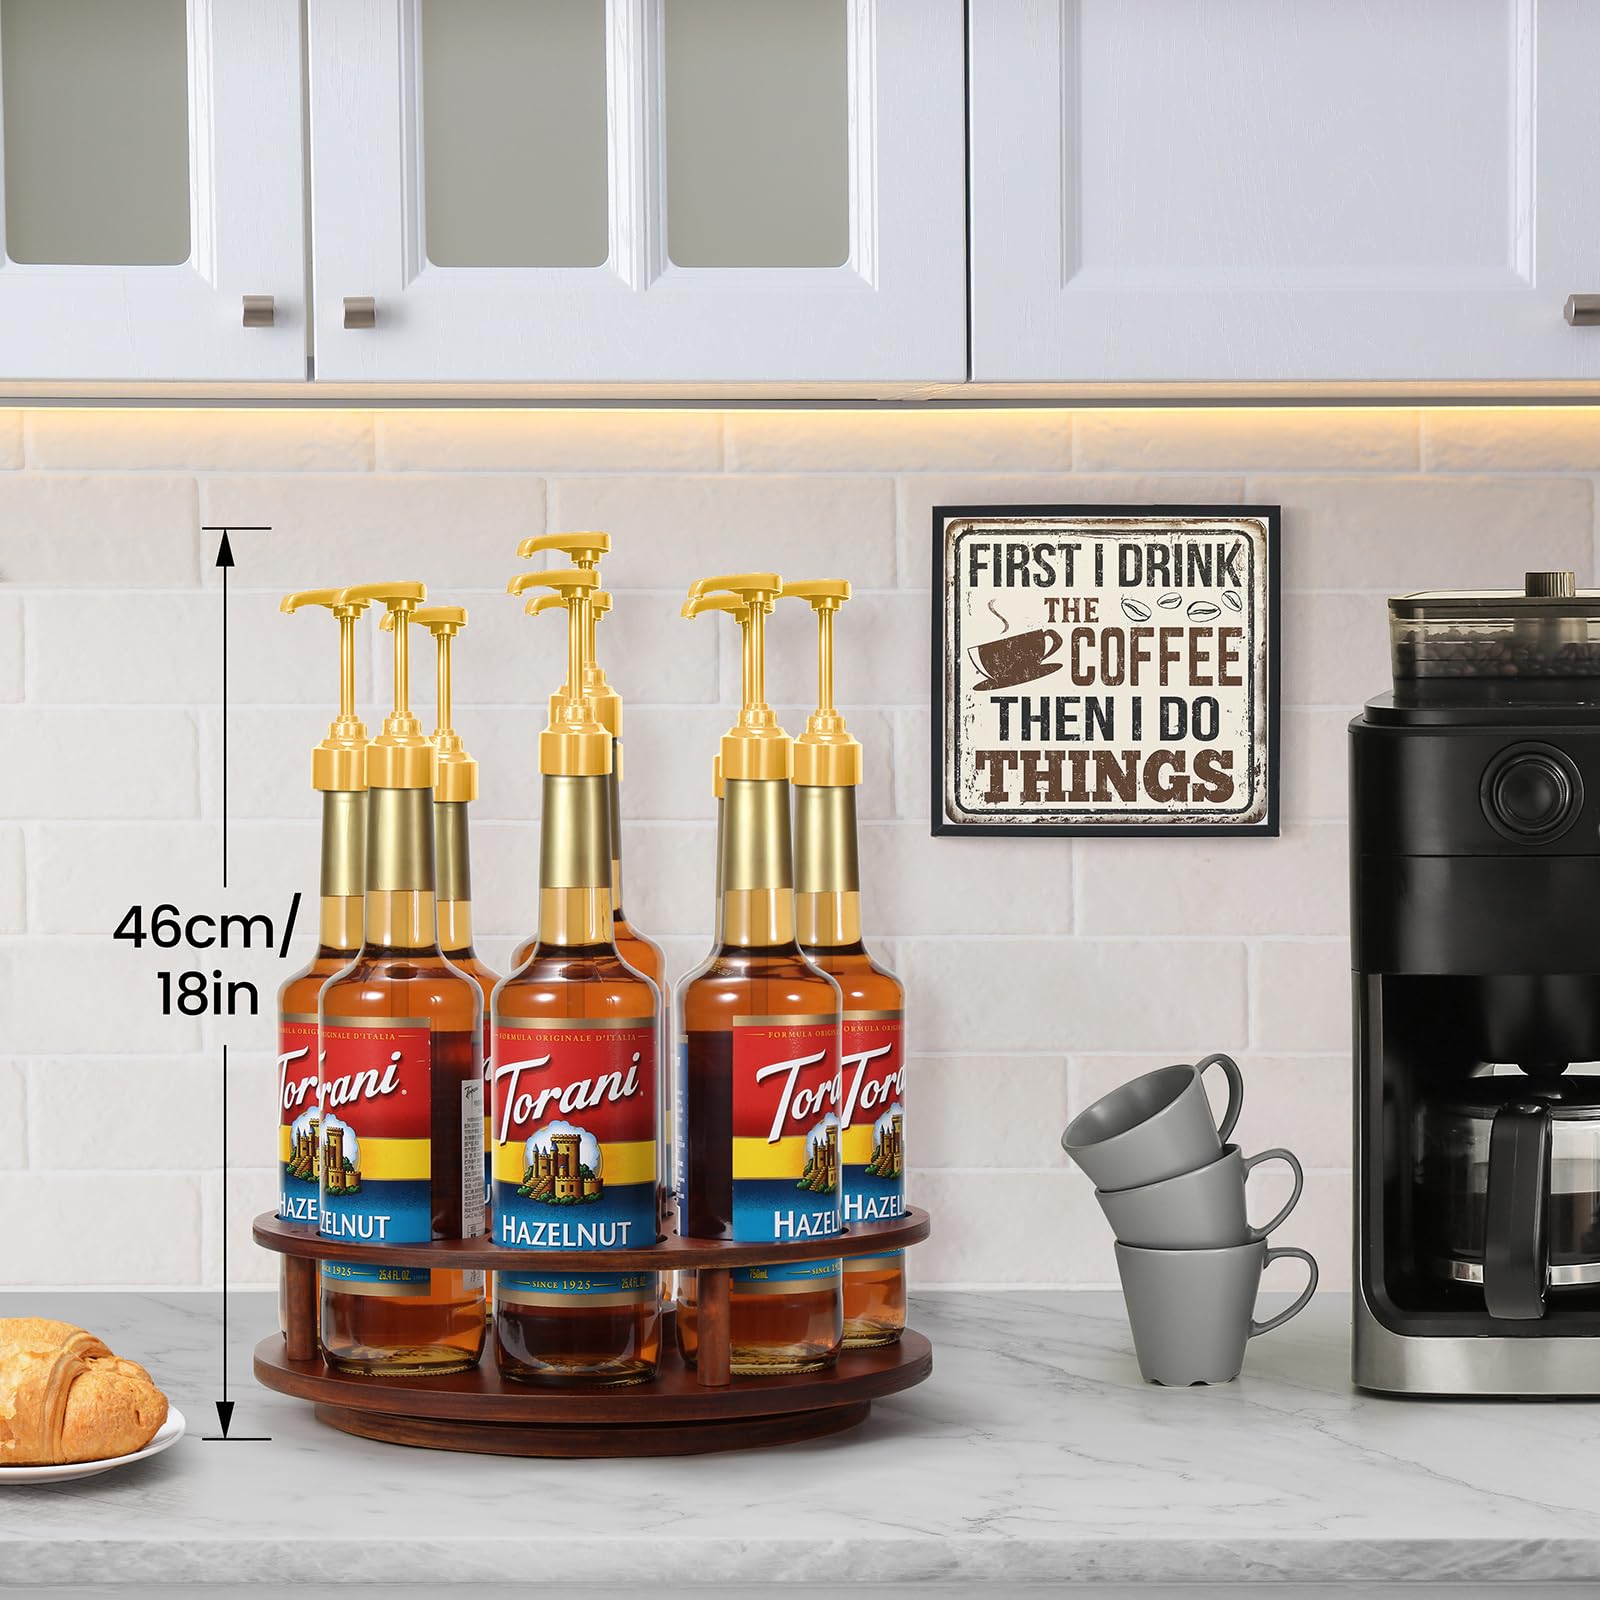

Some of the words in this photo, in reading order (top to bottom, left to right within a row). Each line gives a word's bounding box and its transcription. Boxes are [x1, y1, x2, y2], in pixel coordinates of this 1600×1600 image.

[968, 543, 1082, 588] FIRST
[1094, 543, 1104, 588] I
[1118, 543, 1243, 588] DRINK
[1044, 597, 1100, 624] THE
[1071, 626, 1243, 687] COFFEE
[990, 696, 1115, 742] THEN
[1131, 696, 1142, 742] I
[1159, 696, 1220, 742] DO
[975, 749, 1235, 804] THINGS
[353, 1032, 396, 1041] D'ITALIA
[499, 1033, 532, 1041] FORMULA
[535, 1033, 592, 1042] ORIGINALE
[595, 1033, 636, 1042] D'ITALIA
[768, 1030, 812, 1039] FORMULA
[496, 1052, 640, 1146] Torani
[502, 1215, 632, 1247] HAZELNUT
[332, 1265, 352, 1277] 1925
[811, 1266, 831, 1275] SINCE
[532, 1280, 559, 1290] SINCE
[562, 1279, 592, 1290] 1925
